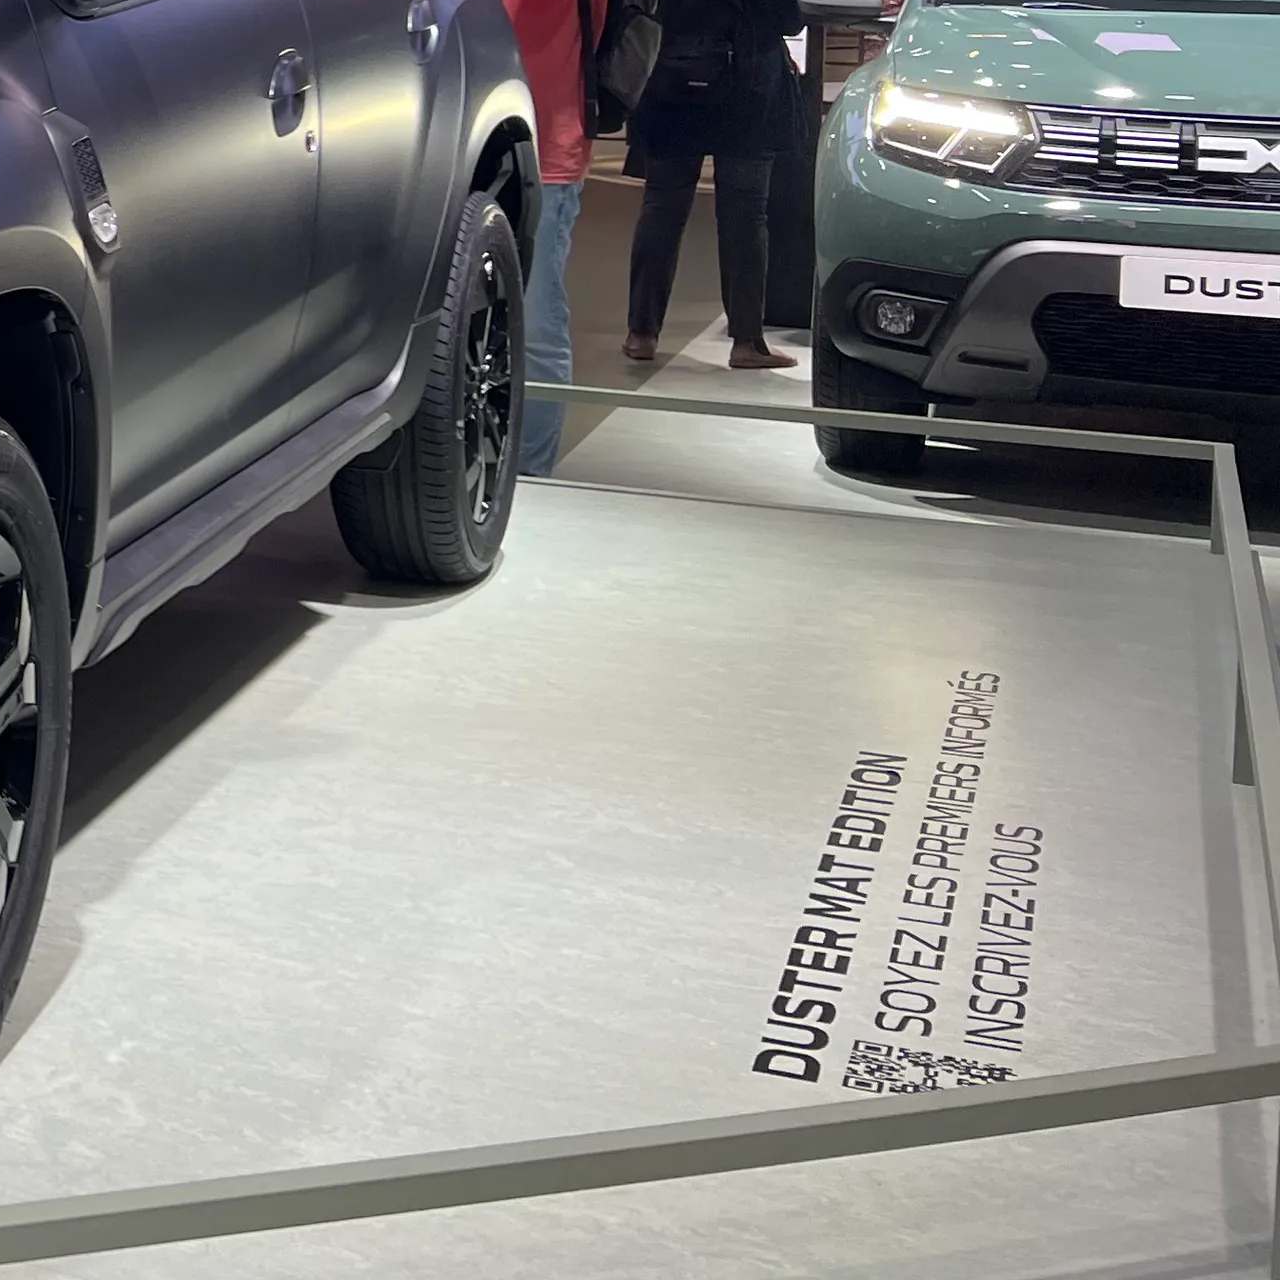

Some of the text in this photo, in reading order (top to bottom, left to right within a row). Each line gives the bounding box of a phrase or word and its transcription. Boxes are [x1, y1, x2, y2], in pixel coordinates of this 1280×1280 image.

[752, 751, 907, 1083] DUSTER MAT EDITION
[875, 670, 1000, 1037] SOYEZ LES PREMIERS INFORMÉS
[964, 823, 1043, 1053] INSCRIVEZ-VOUS
